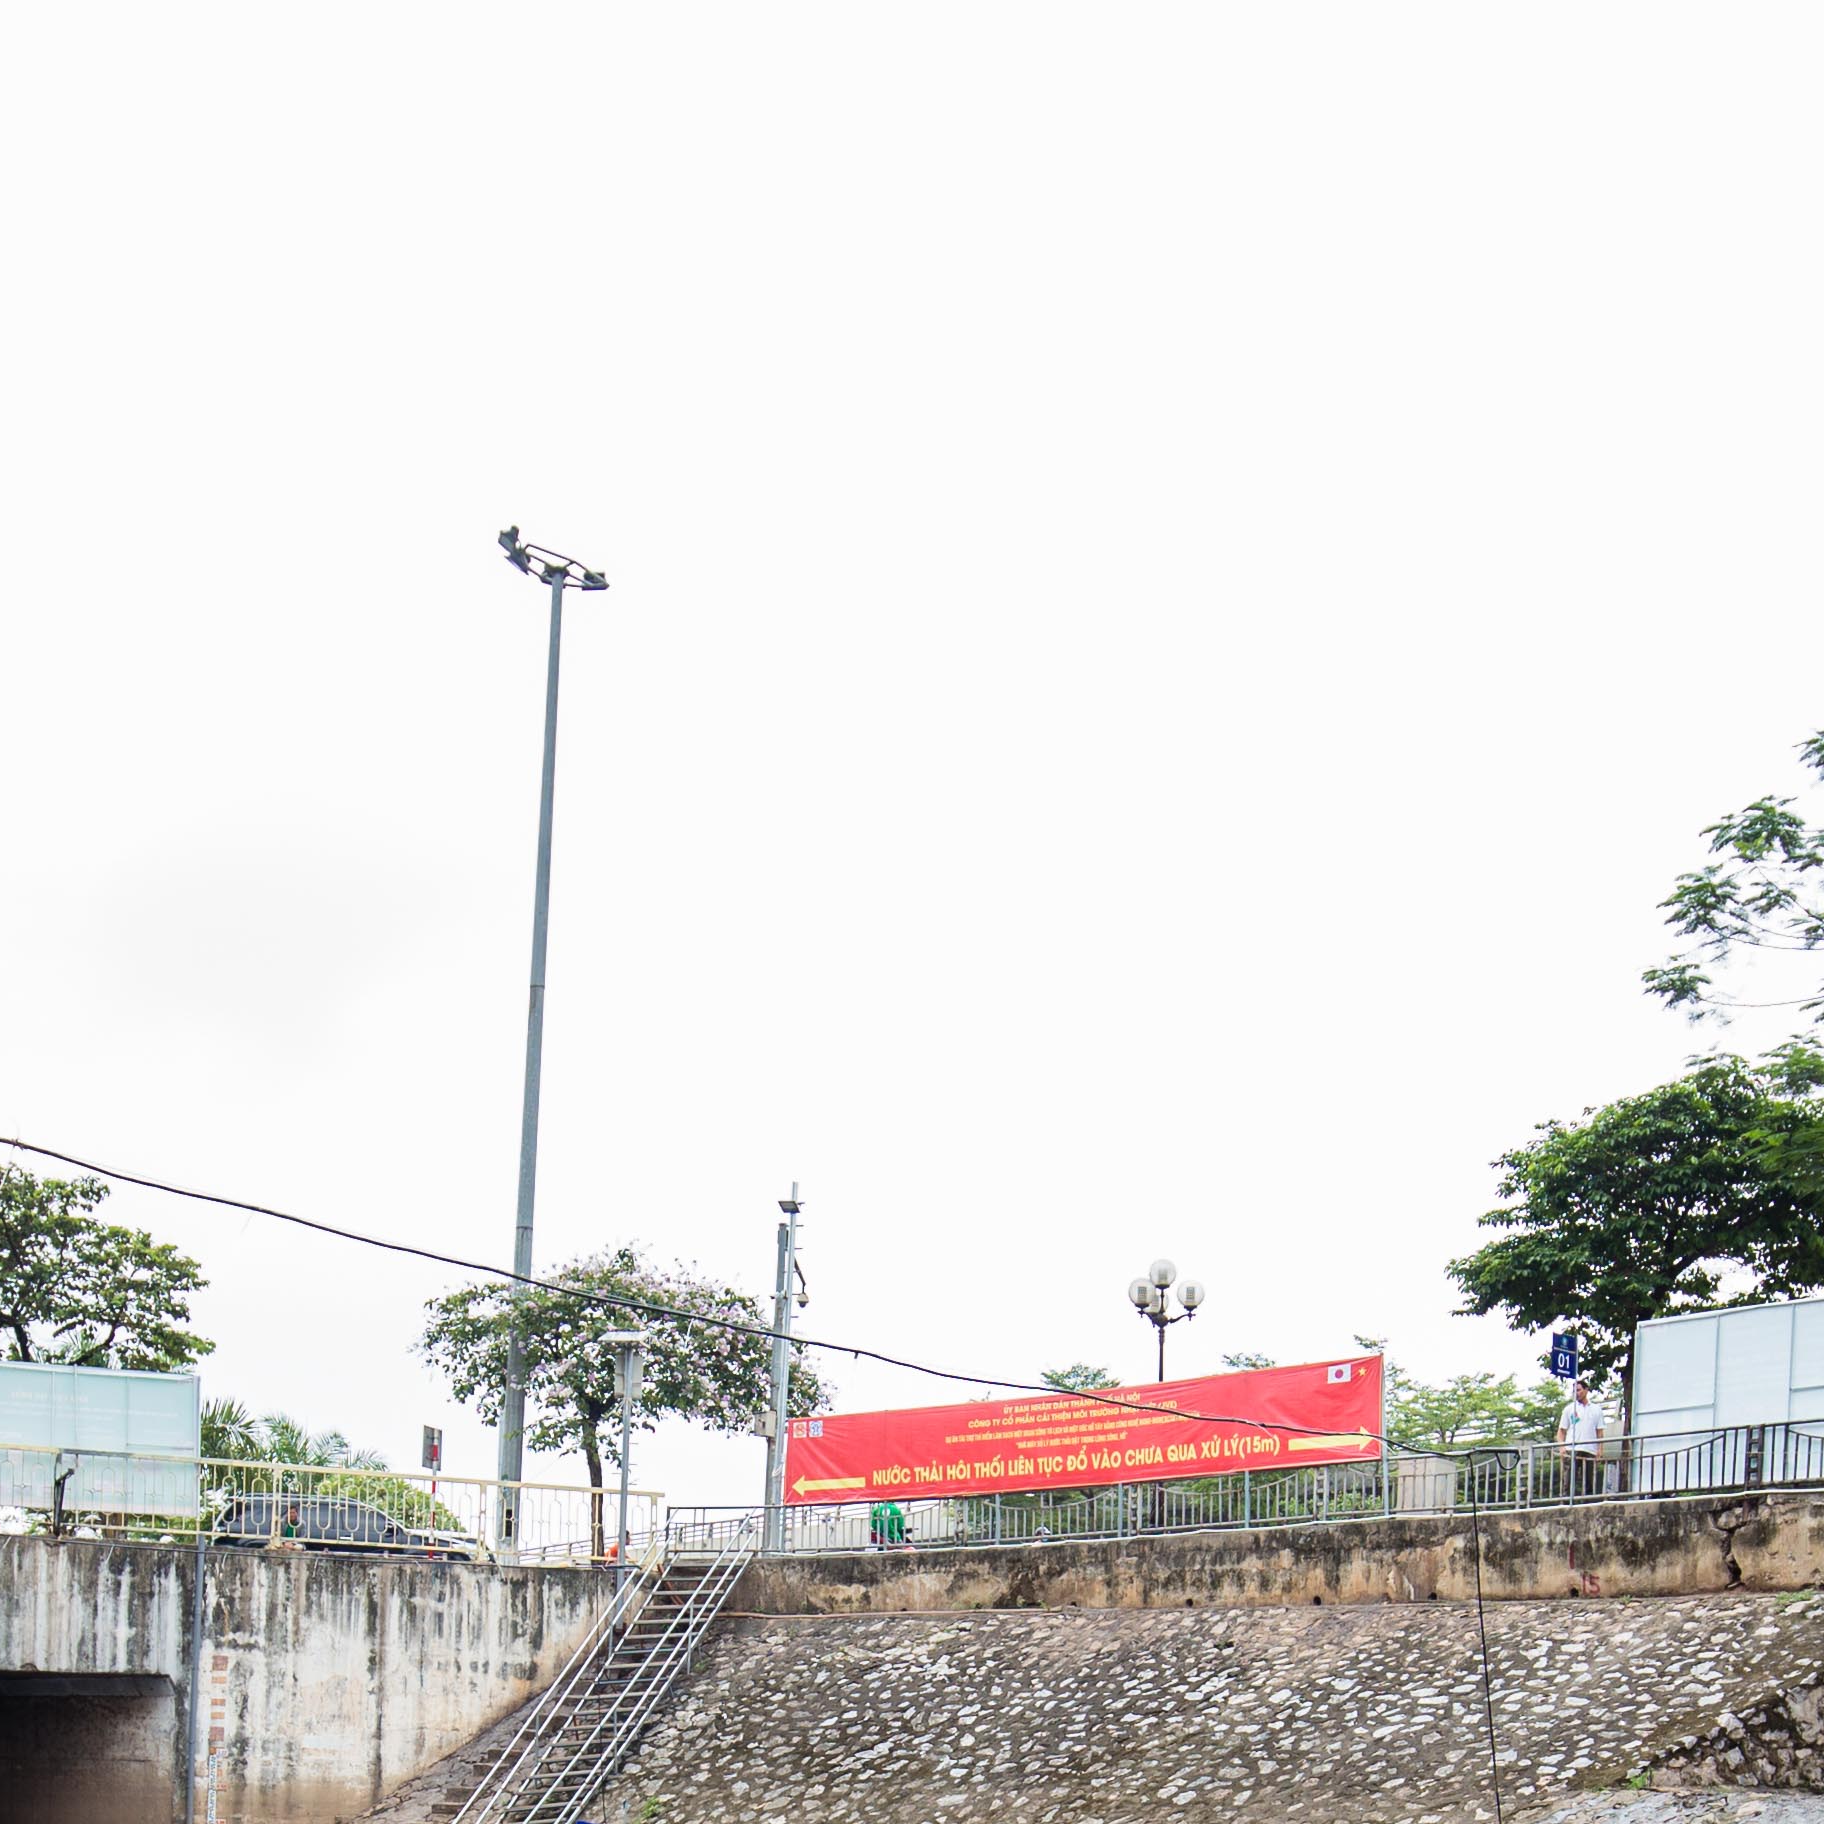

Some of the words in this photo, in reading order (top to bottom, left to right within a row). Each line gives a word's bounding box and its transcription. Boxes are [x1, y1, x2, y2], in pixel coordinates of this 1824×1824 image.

[1557, 1353, 1570, 1369] 01
[872, 1464, 911, 1486] NƯỚC
[914, 1460, 943, 1484] THẢI
[946, 1460, 971, 1481] HÔI
[974, 1453, 1005, 1478] THỐI
[1008, 1455, 1034, 1476] LIÊN
[1037, 1455, 1063, 1478] TỤC
[1066, 1445, 1088, 1471] ĐỔ
[1091, 1448, 1122, 1470] VÀO
[1125, 1444, 1164, 1467] CHƯA
[1166, 1442, 1197, 1463] QUA
[1200, 1434, 1220, 1459] XỬ
[1581, 1572, 1601, 1598] 15
